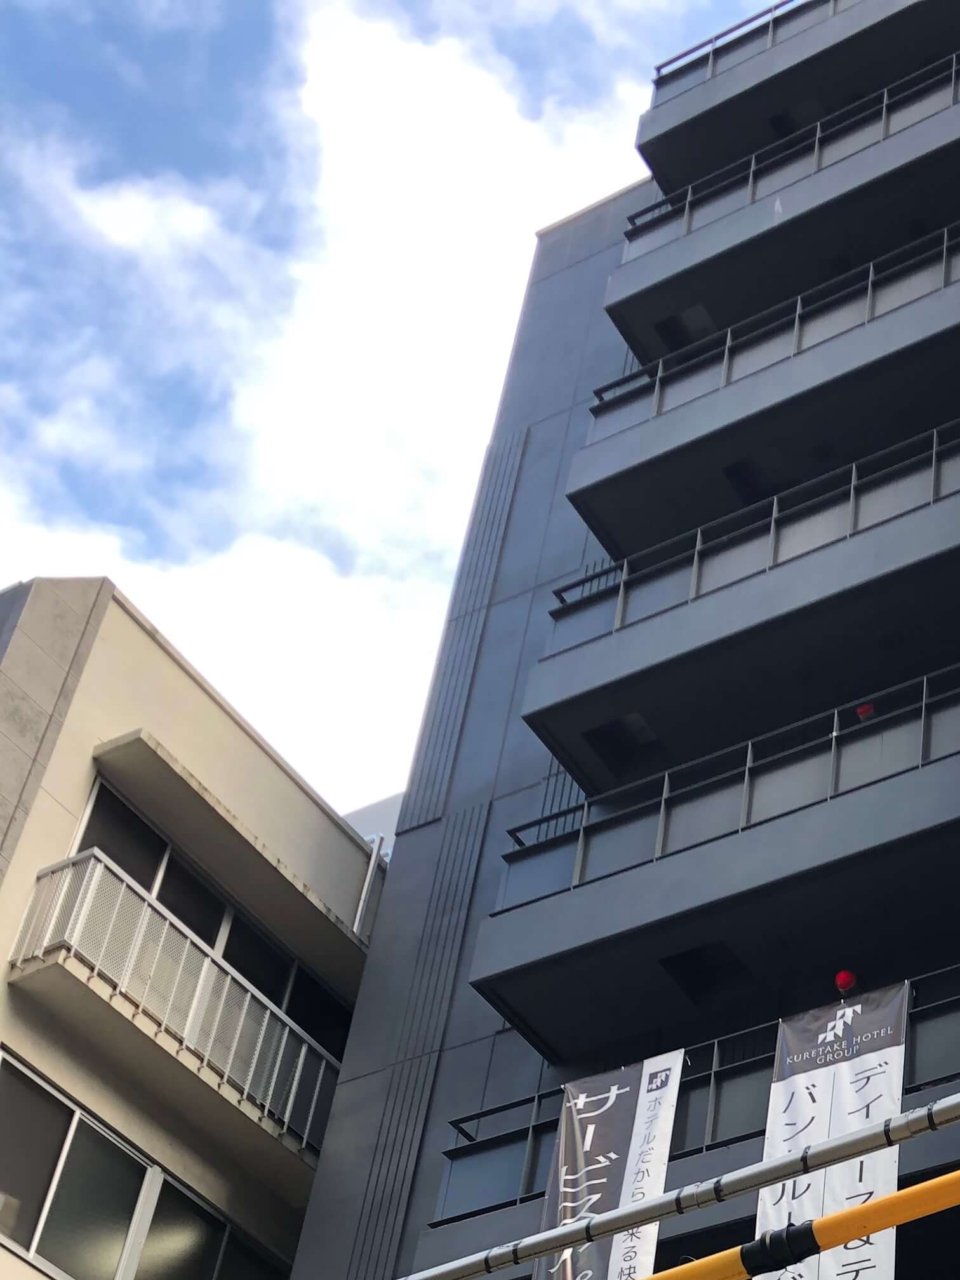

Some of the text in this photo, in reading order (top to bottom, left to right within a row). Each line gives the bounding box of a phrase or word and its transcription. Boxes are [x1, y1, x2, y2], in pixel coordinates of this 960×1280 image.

[786, 1026, 894, 1065] KURETAKE HOTEL
[816, 1045, 860, 1065] GROUP
